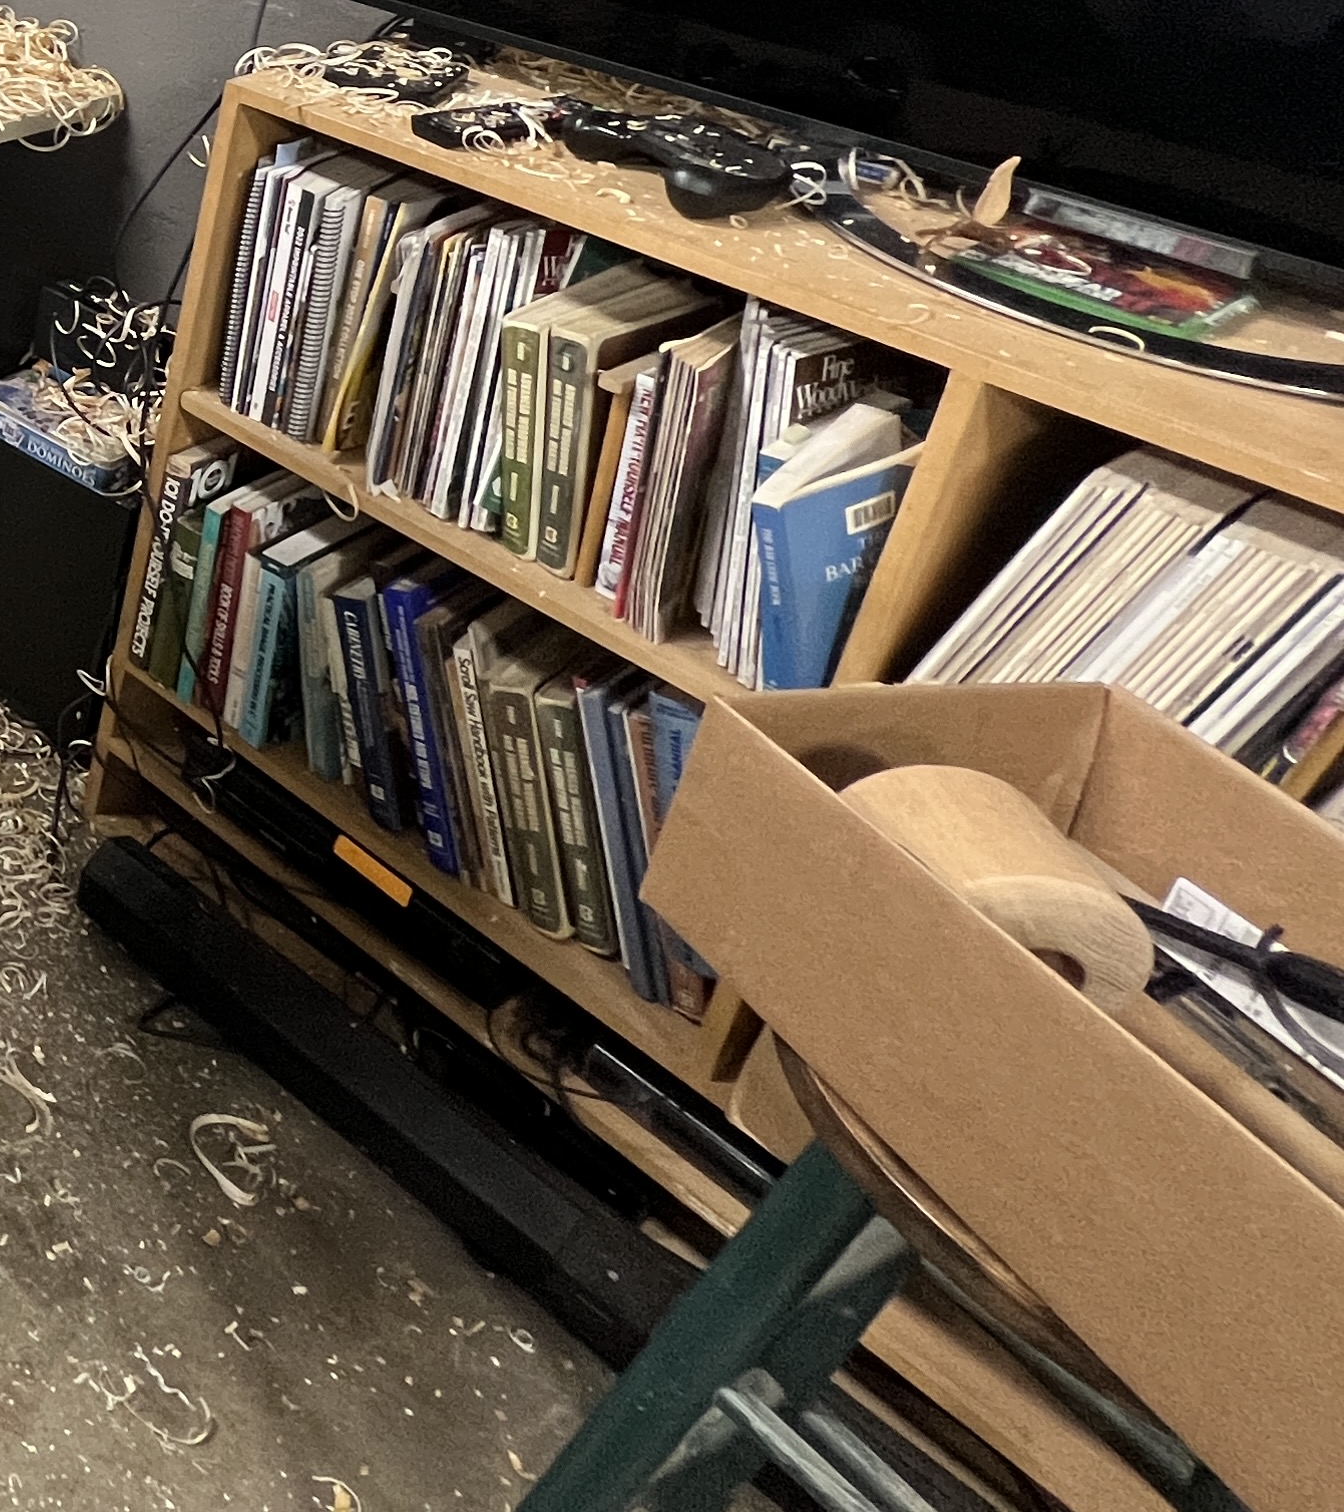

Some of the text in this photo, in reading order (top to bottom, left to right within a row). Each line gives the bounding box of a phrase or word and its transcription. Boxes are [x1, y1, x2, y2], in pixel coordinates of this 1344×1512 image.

[27, 441, 97, 486] DOMINOES
[132, 596, 155, 658] PROJECTS
[457, 655, 476, 691] Scroll
[463, 690, 480, 716] Saw
[468, 716, 491, 778] Handbook
